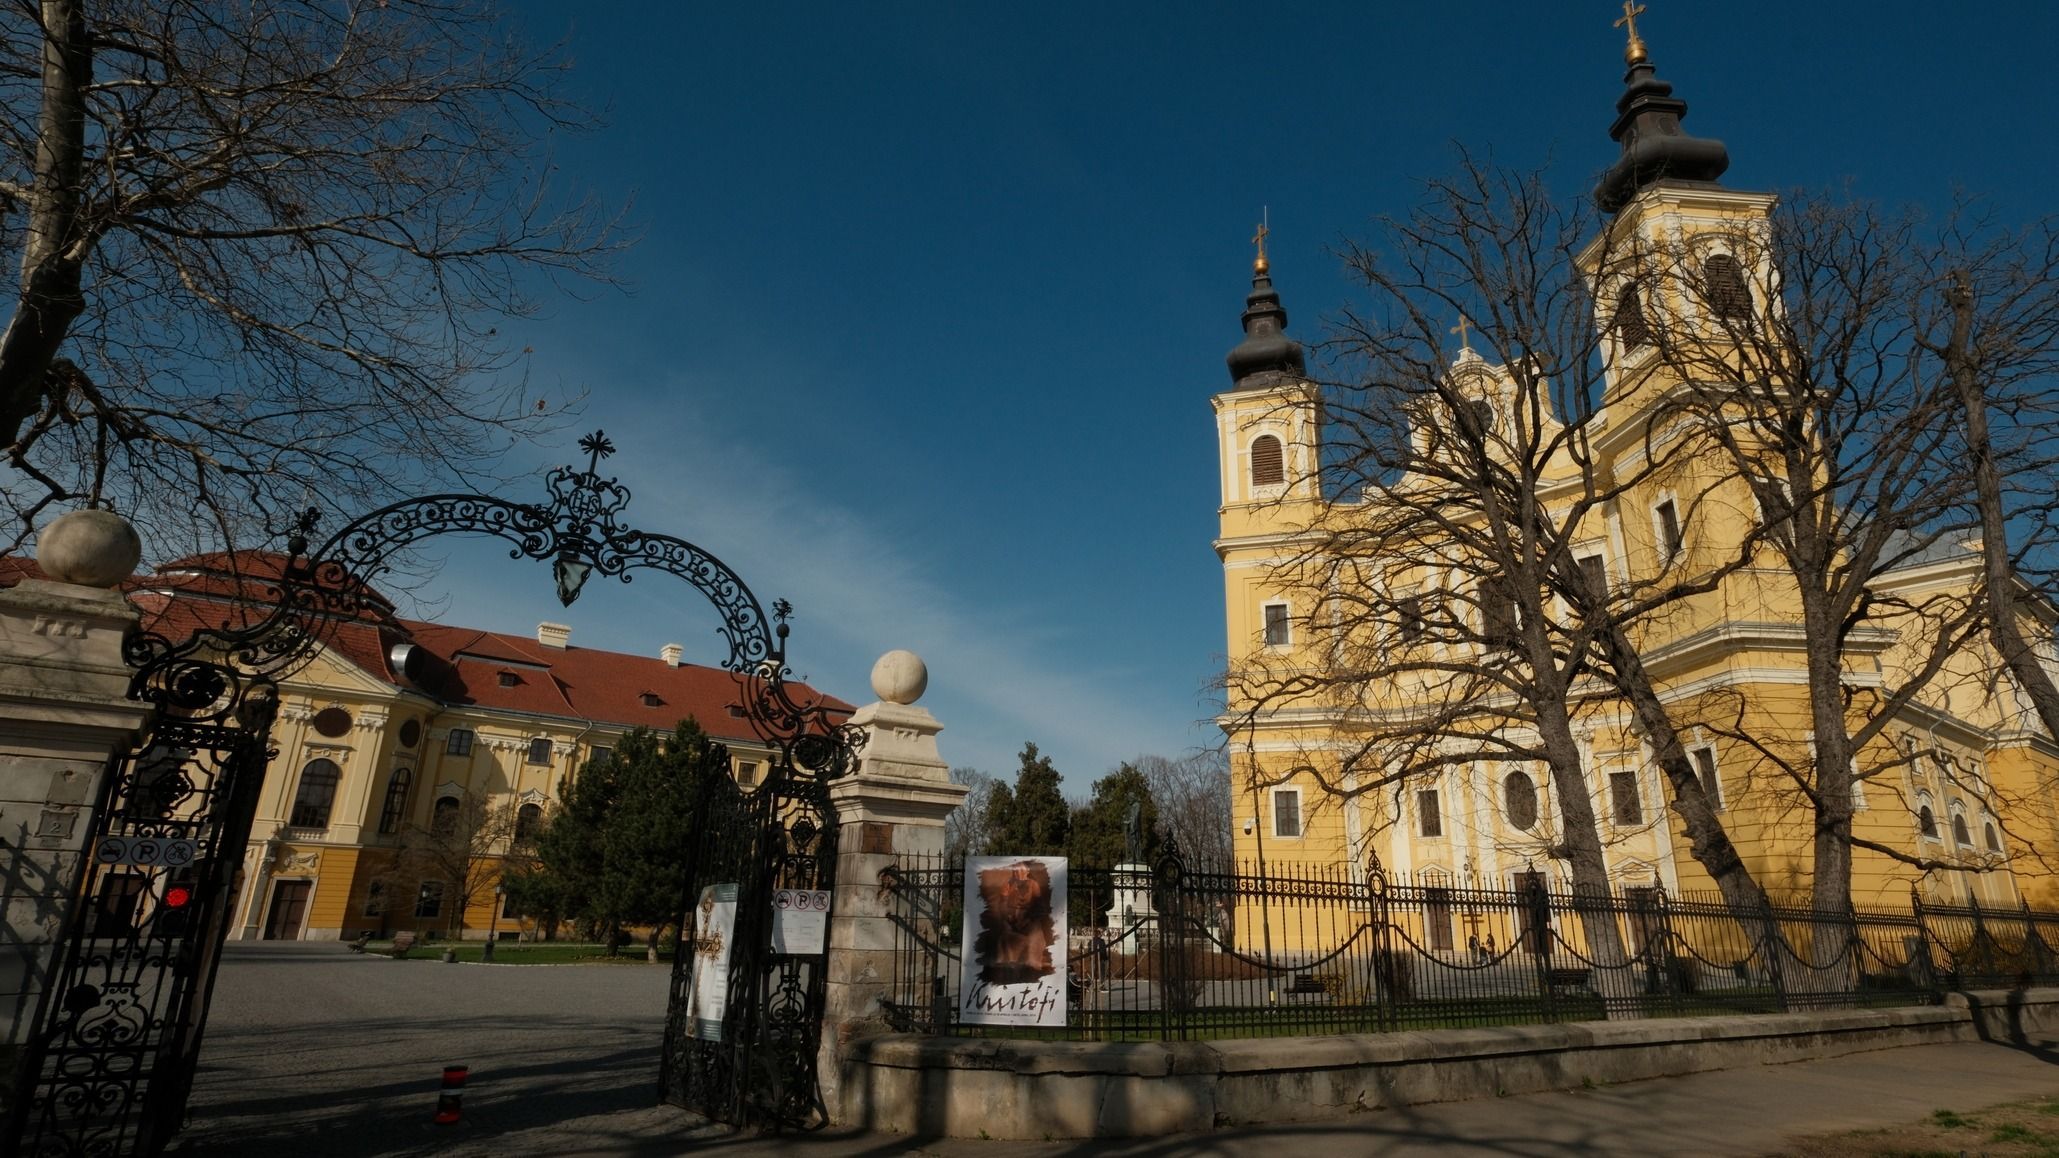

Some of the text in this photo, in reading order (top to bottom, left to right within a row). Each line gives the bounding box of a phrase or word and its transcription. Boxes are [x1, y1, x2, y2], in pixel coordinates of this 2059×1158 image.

[50, 822, 61, 833] 2
[138, 845, 154, 860] P
[798, 895, 808, 906] P
